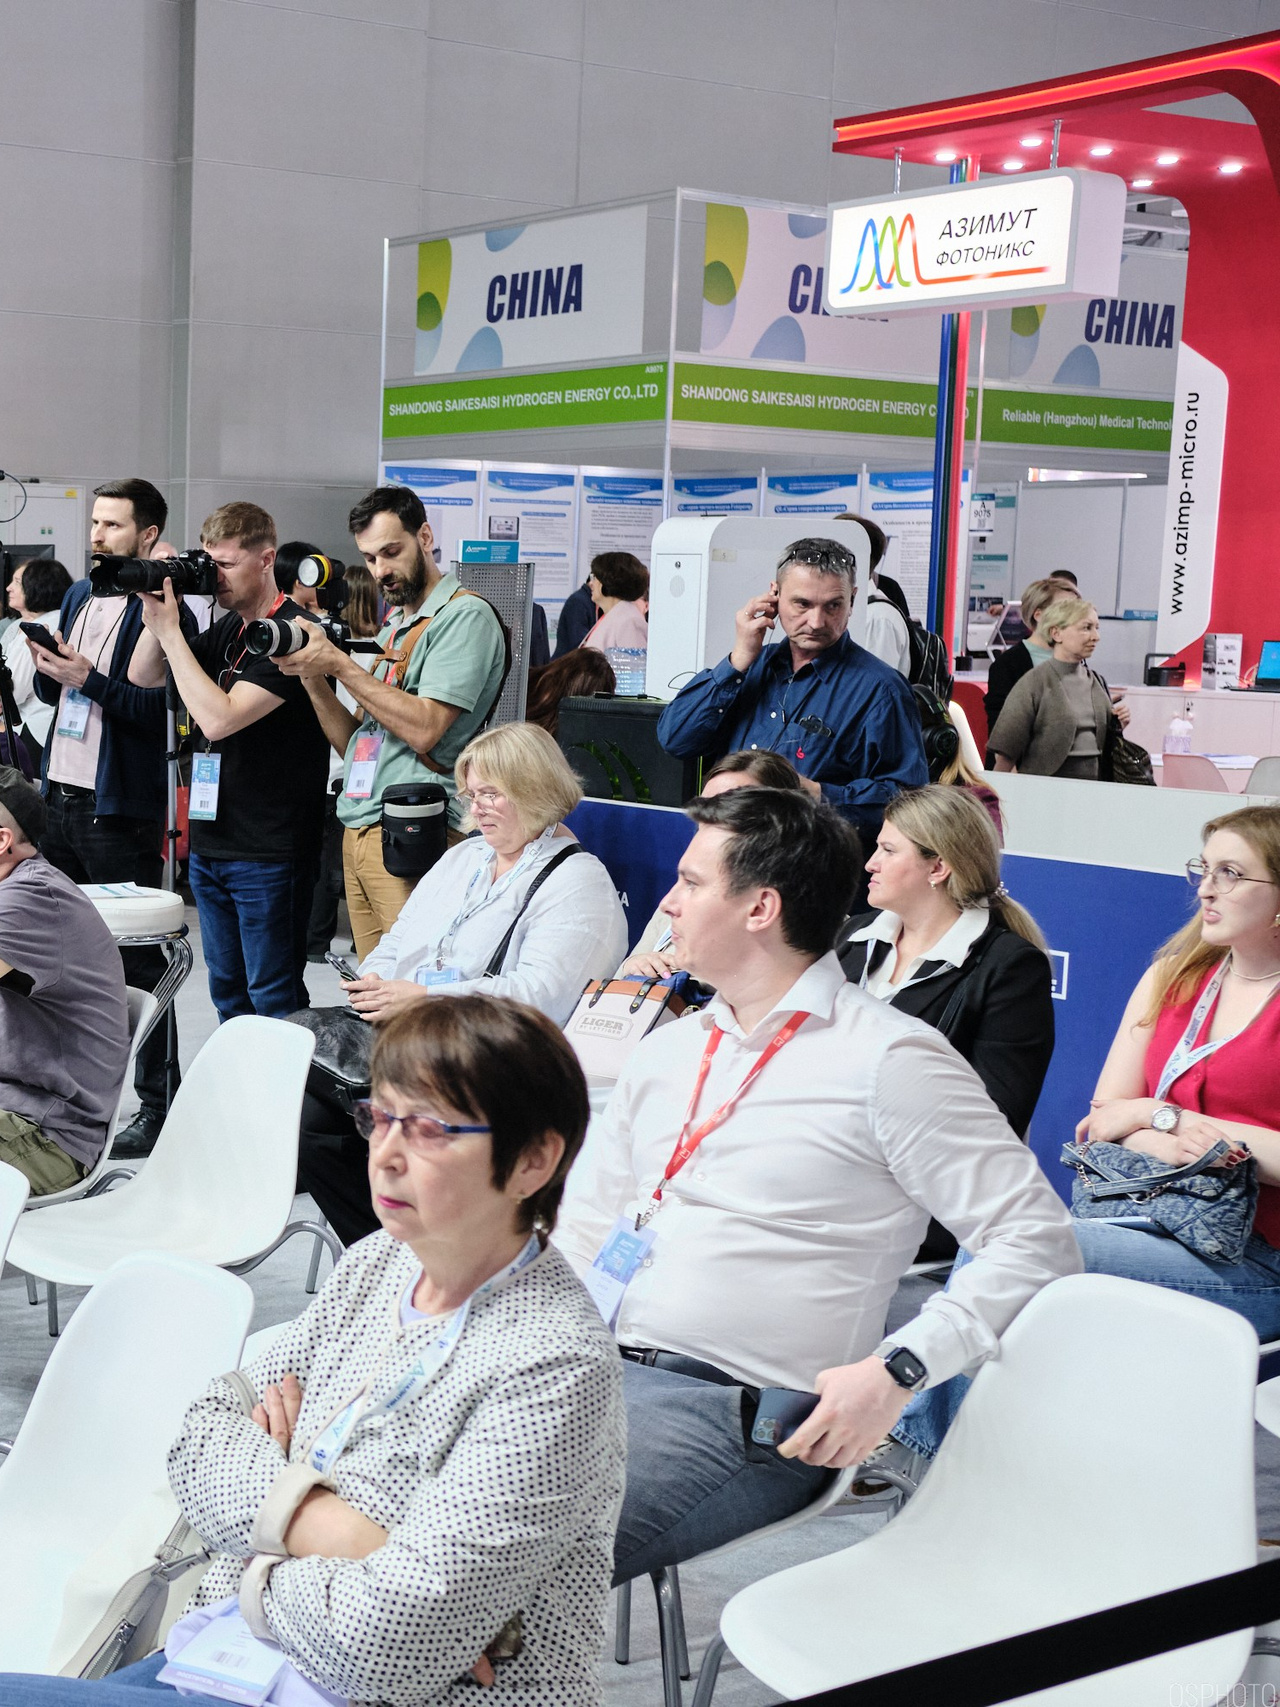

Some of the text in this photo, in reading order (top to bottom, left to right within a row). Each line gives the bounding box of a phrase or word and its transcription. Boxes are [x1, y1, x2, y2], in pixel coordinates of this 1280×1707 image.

[938, 207, 1038, 240] АЗИМУТ
[935, 240, 1036, 267] ФОТОНИКС
[486, 264, 583, 323] CHINA
[1084, 298, 1176, 348] CHINA
[388, 383, 658, 416] SHANDONG SAIKESAISI HYDROGEN ENERGY CO.,LTD
[681, 384, 749, 402] SHANDONG
[751, 390, 815, 408] SAIKESAISI
[817, 394, 880, 414] HYDROGEN
[882, 400, 926, 416] ENERGY
[1002, 408, 1042, 426] Reliable
[1043, 410, 1097, 429] (Hangzhou)
[1099, 414, 1134, 429] Medical
[974, 510, 992, 518] 9075
[1171, 392, 1200, 616] www.azimp-micro.ru
[582, 1018, 624, 1030] LIGER
